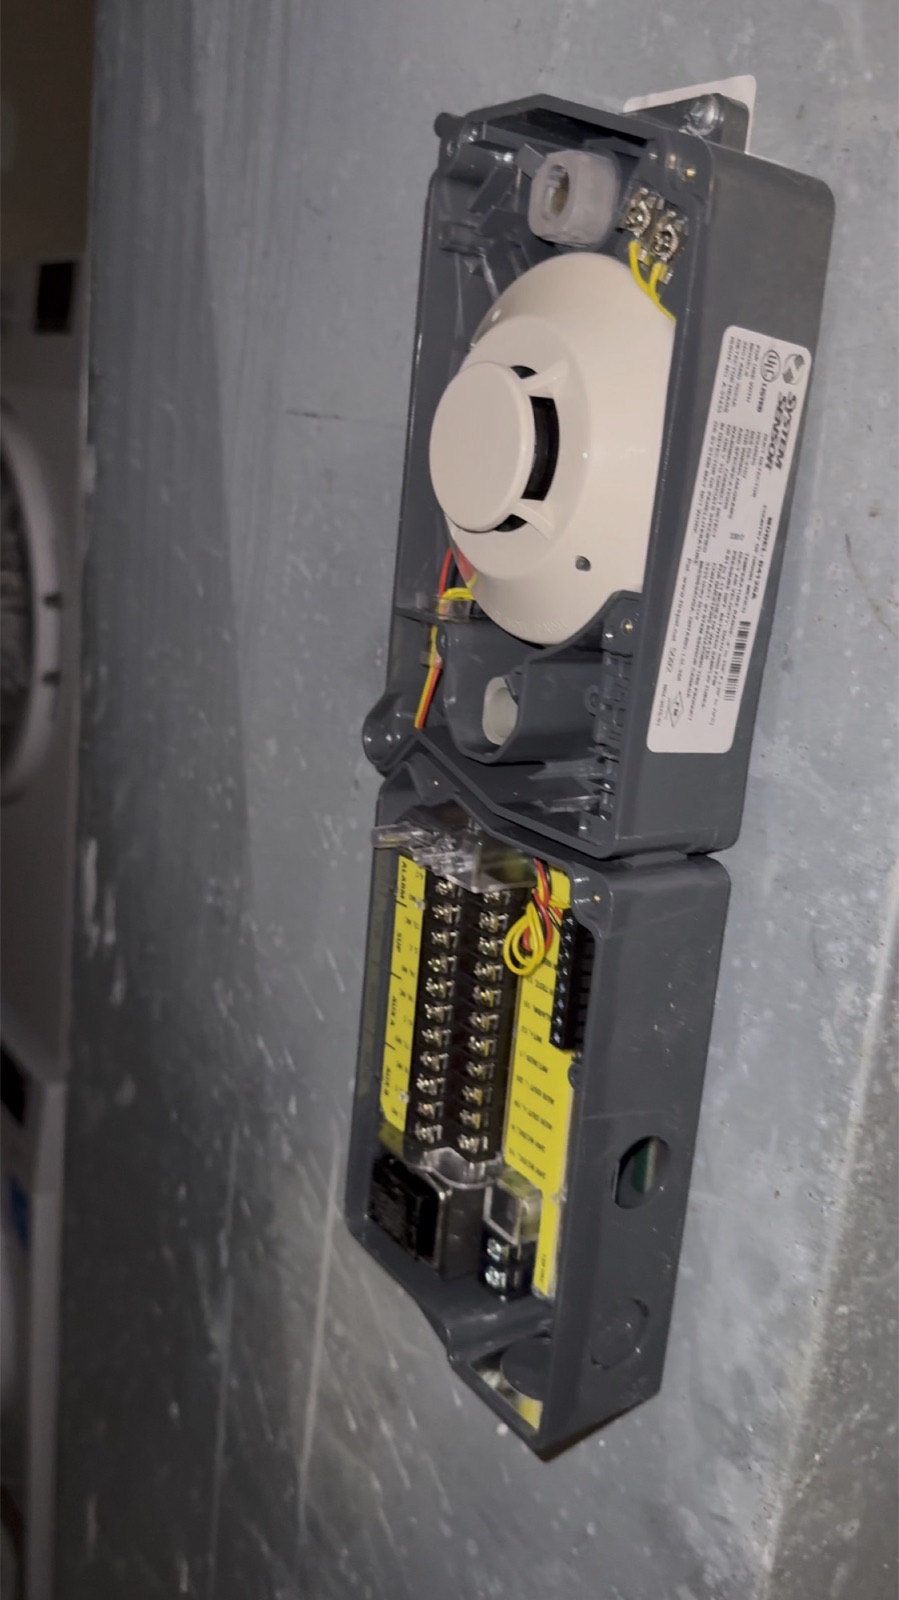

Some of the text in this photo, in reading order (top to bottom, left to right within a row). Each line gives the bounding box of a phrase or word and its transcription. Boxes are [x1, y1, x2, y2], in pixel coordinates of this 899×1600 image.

[763, 392, 787, 470] SENSOR
[773, 391, 798, 470] SYSTEM
[400, 861, 408, 900] ALARM
